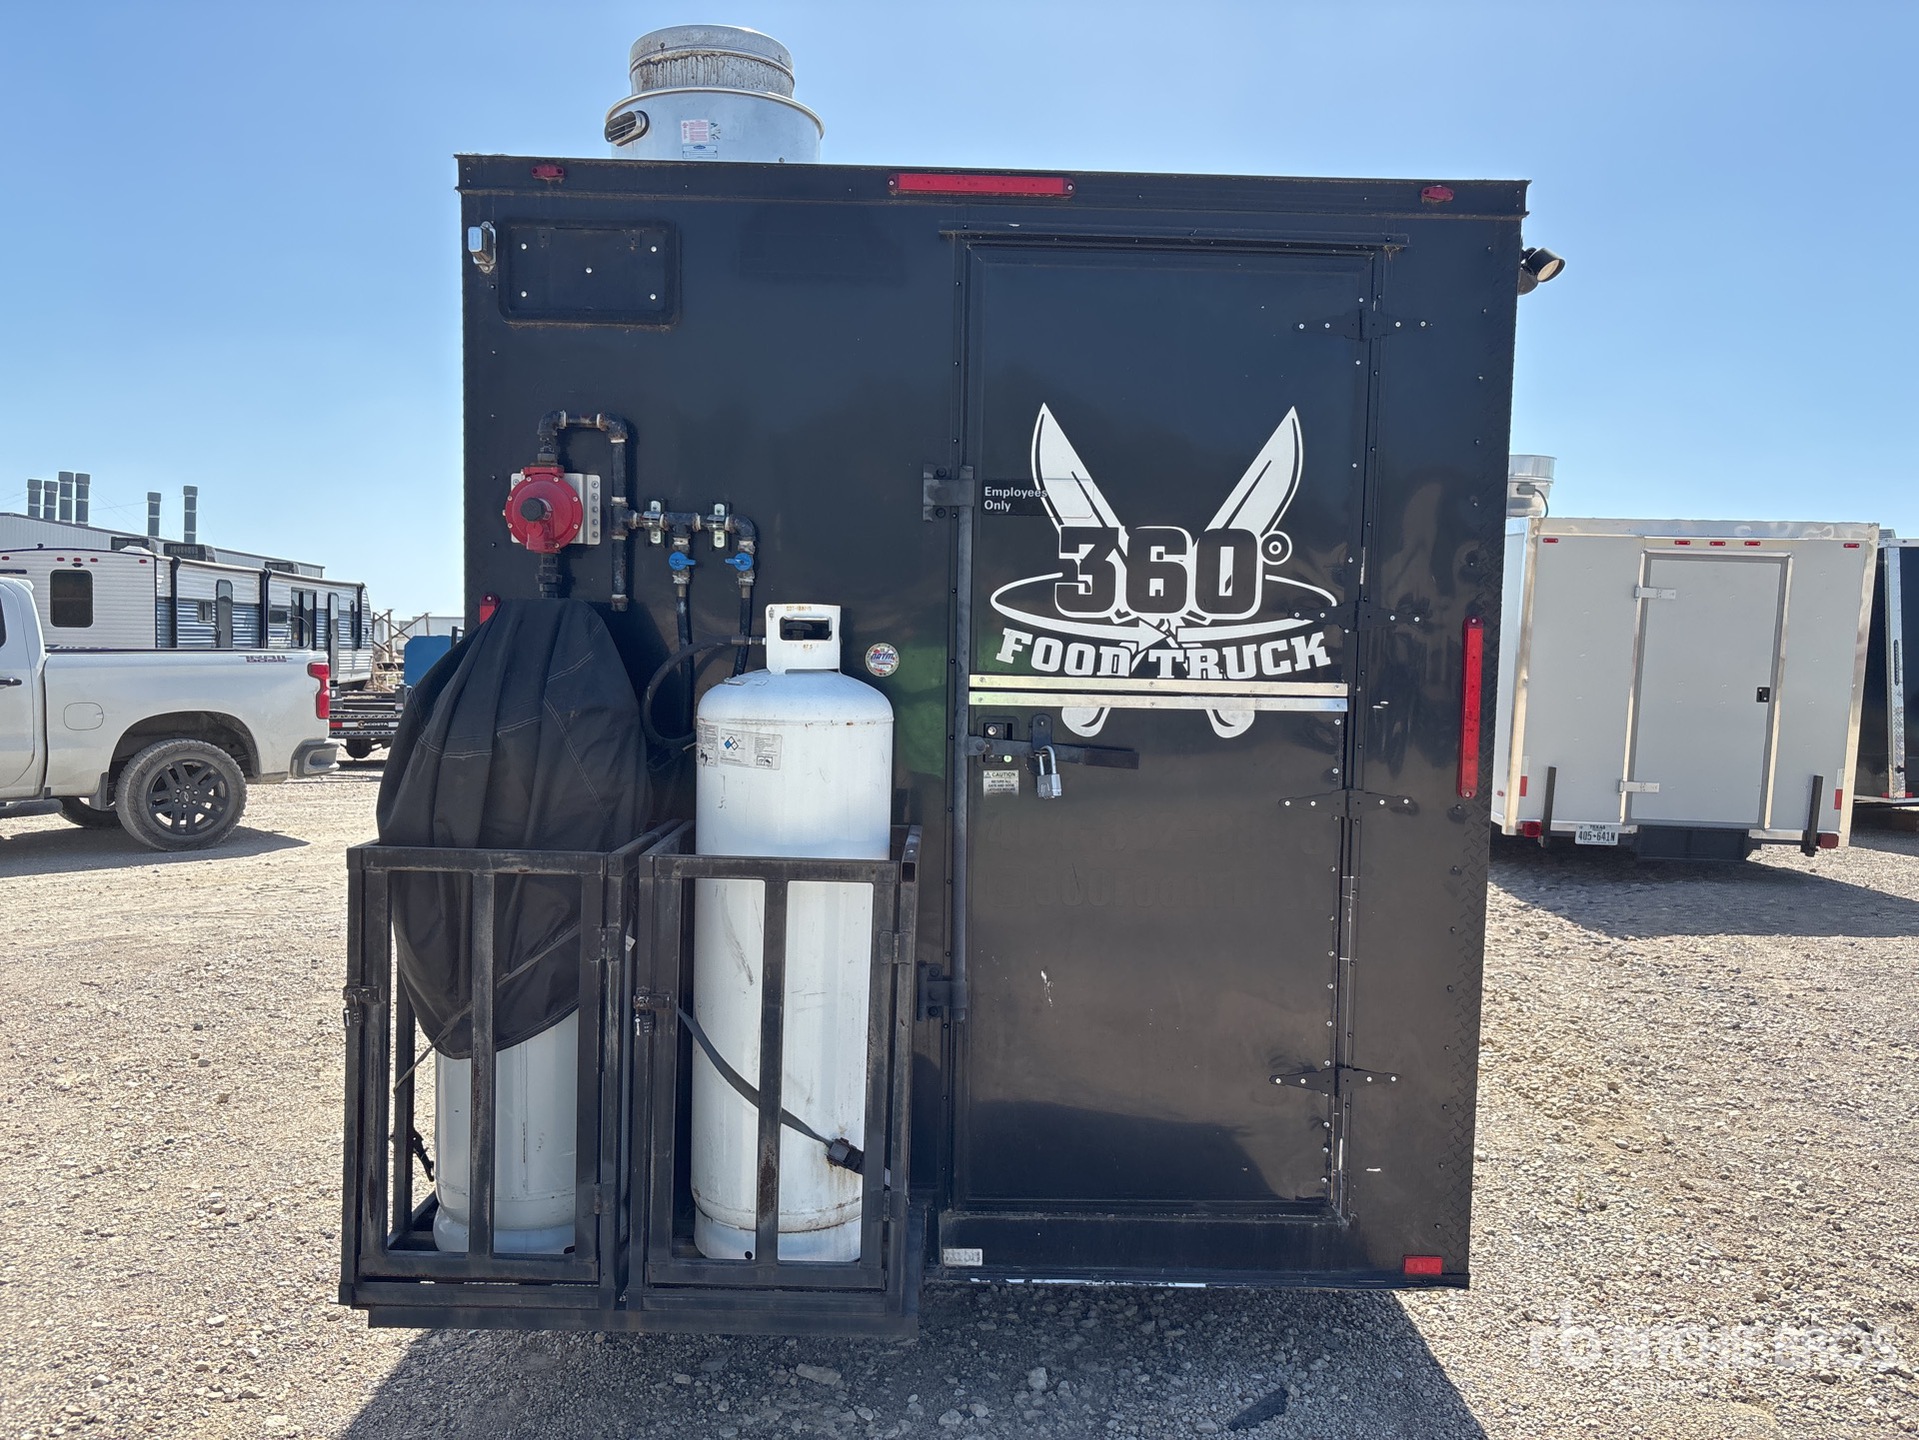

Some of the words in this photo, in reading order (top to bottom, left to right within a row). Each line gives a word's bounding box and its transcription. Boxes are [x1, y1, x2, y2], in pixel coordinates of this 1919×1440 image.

[984, 486, 1048, 499] Employees
[984, 500, 1011, 512] Only
[995, 627, 1132, 678] FOOD
[1148, 631, 1332, 680] TRUCK
